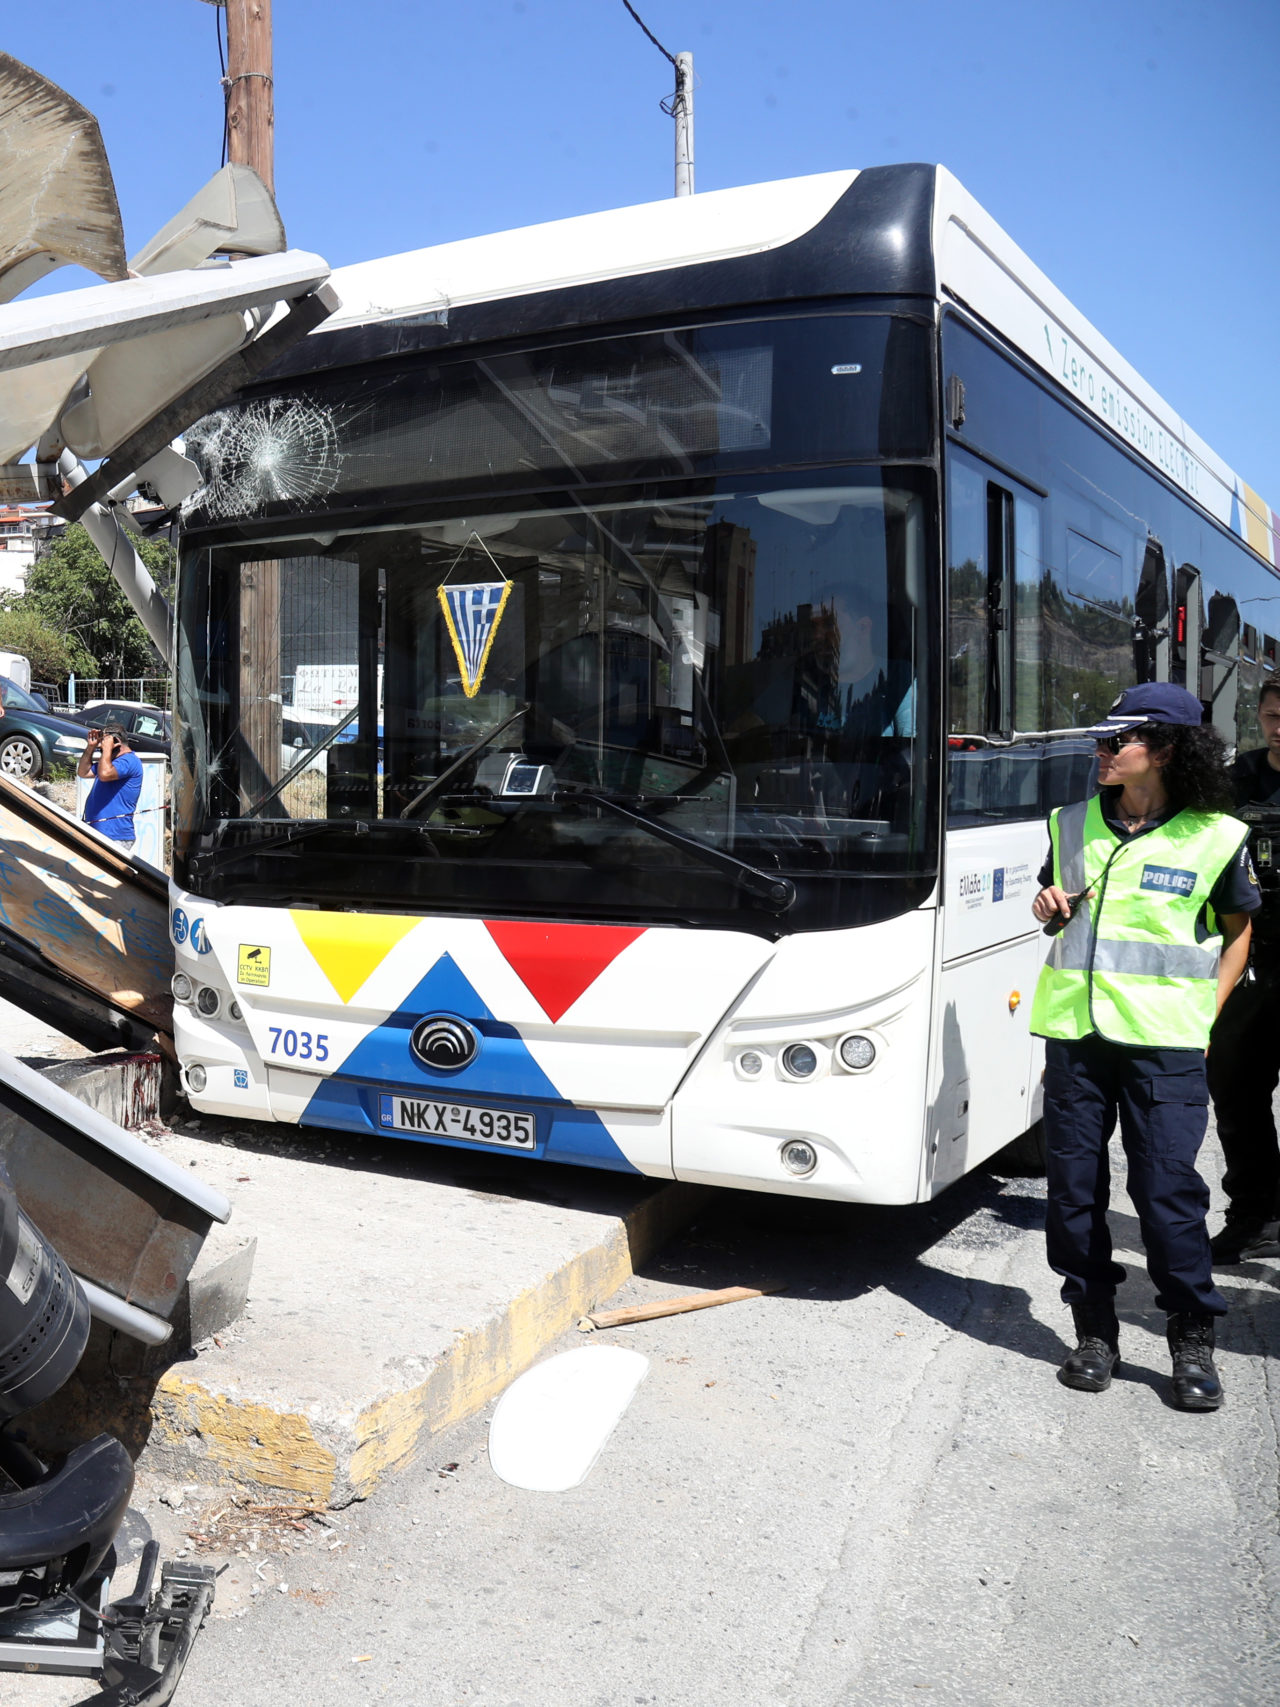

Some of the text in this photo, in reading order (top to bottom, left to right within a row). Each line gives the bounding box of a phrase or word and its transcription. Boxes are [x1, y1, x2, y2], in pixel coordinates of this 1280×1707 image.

[1061, 337, 1199, 495] Zero emission ELECTRIC
[299, 669, 359, 678] ΦΩΤΙΣΜ
[1142, 870, 1196, 892] POLICE
[268, 1026, 329, 1062] 7035
[381, 1100, 530, 1144] GR NKX-4935
